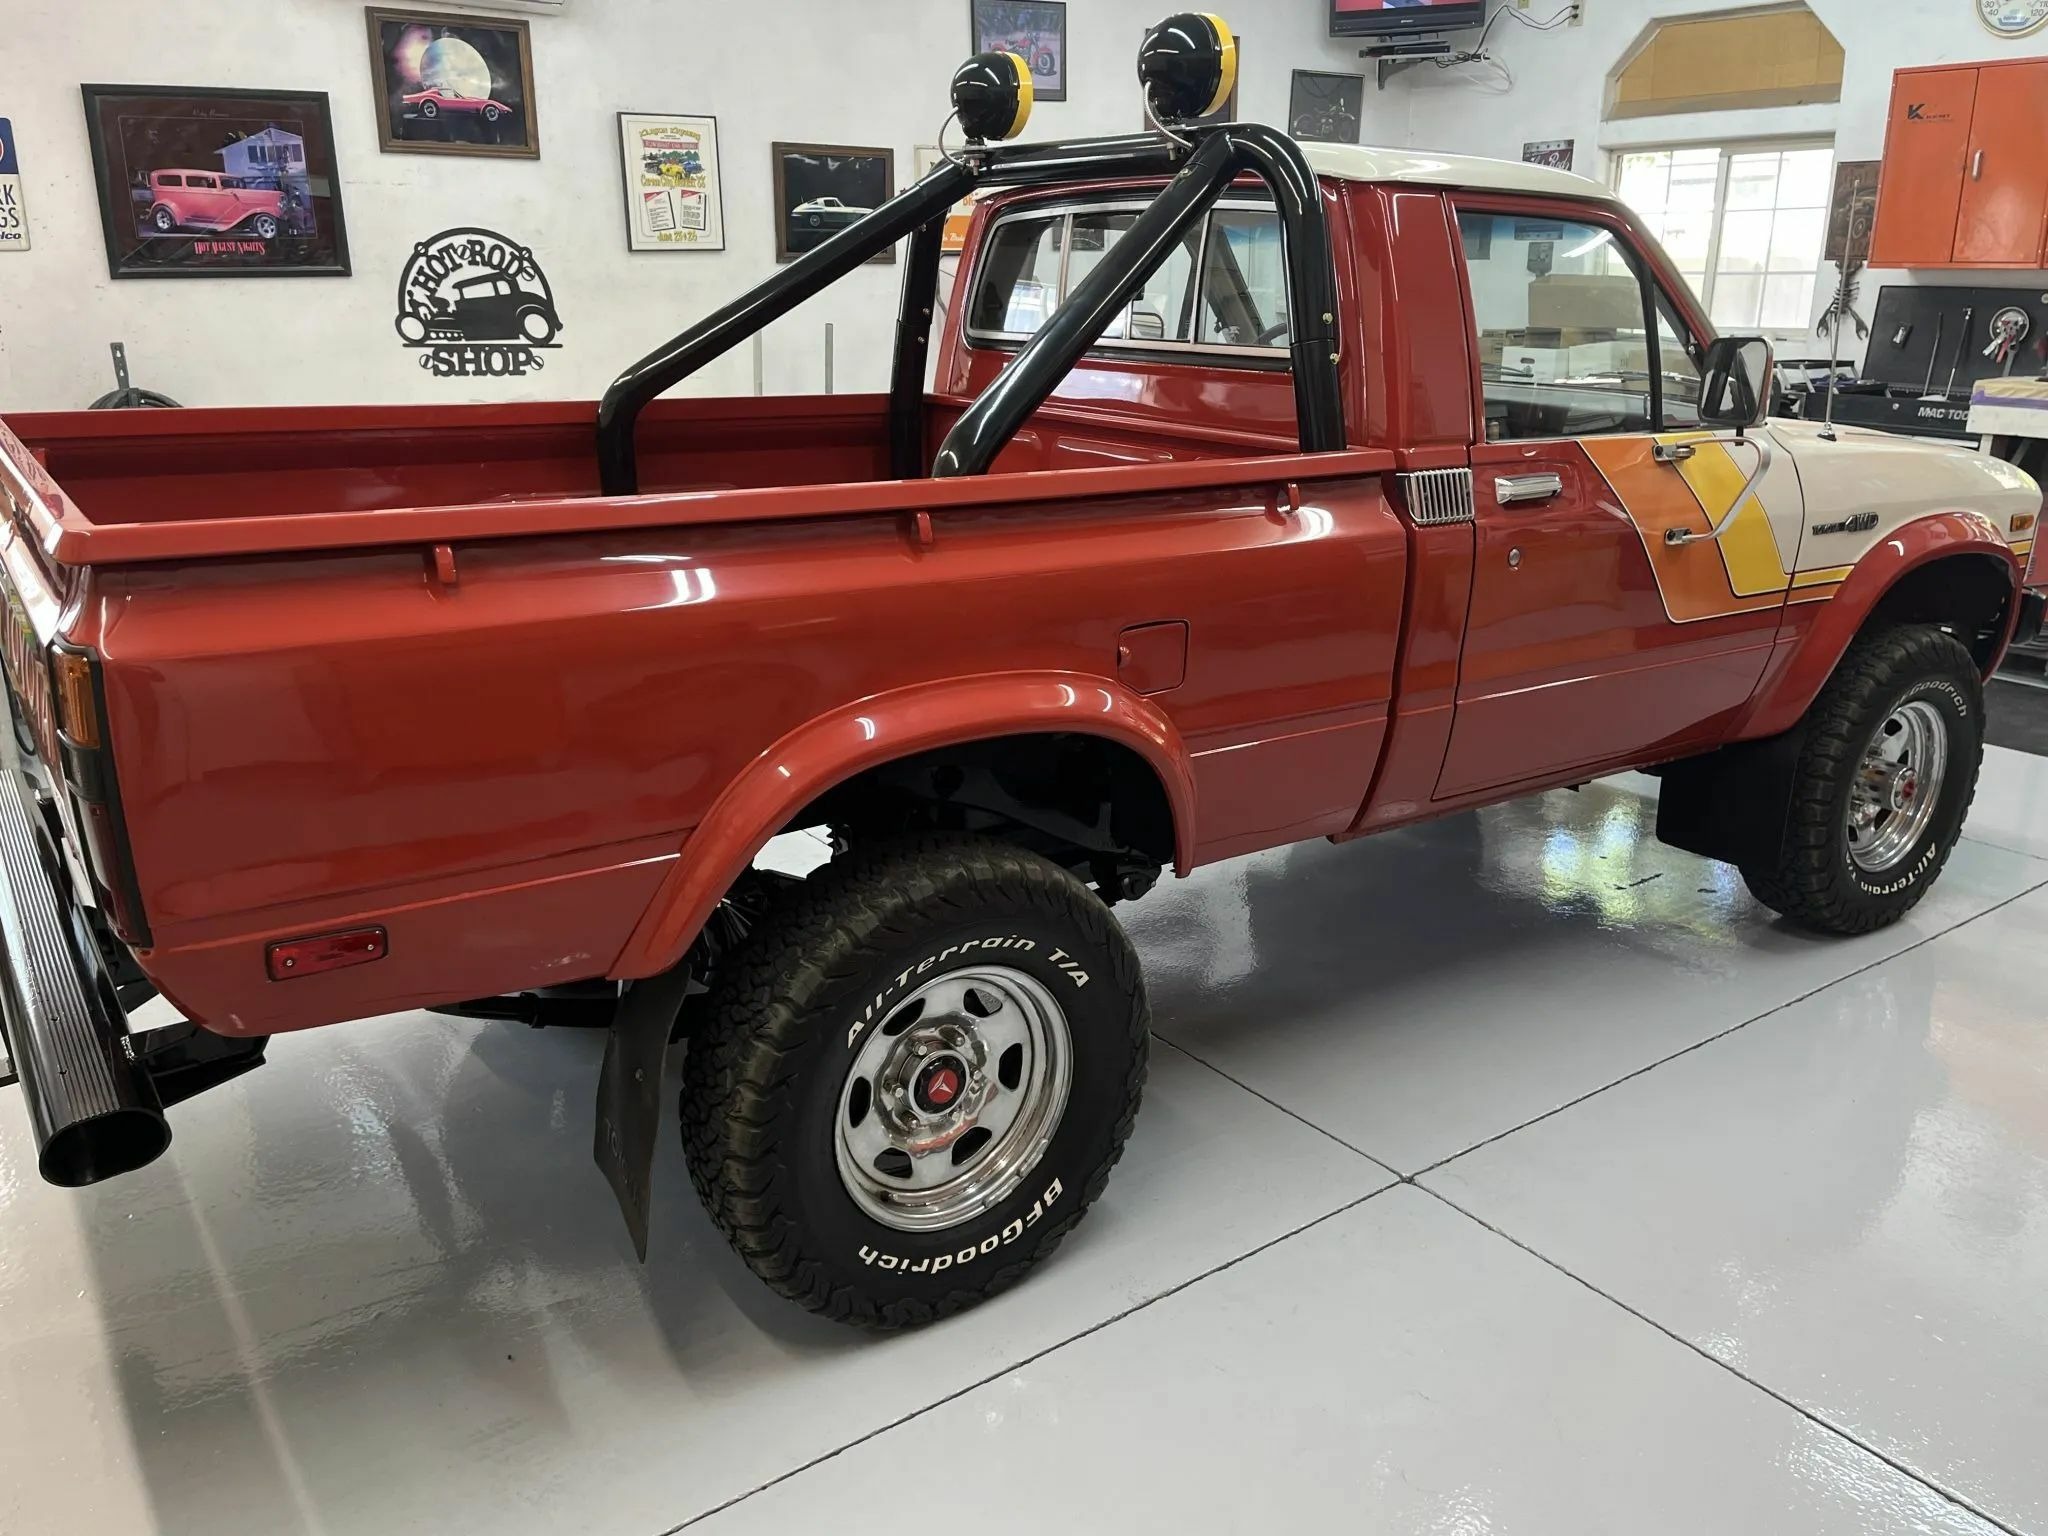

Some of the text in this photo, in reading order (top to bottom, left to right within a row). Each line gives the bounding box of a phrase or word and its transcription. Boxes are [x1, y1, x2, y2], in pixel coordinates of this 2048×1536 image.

[194, 241, 266, 256] HOT AUGUST NIGHTS
[411, 239, 524, 296] HOT ROD
[432, 347, 534, 377] SHOP
[1918, 407, 1945, 418] MAC
[1845, 512, 1879, 532] 4WD
[1861, 842, 1936, 895] All-Terrain
[848, 934, 1091, 1049] All-Terrain T/A
[858, 1177, 1065, 1275] BFGoodrich
